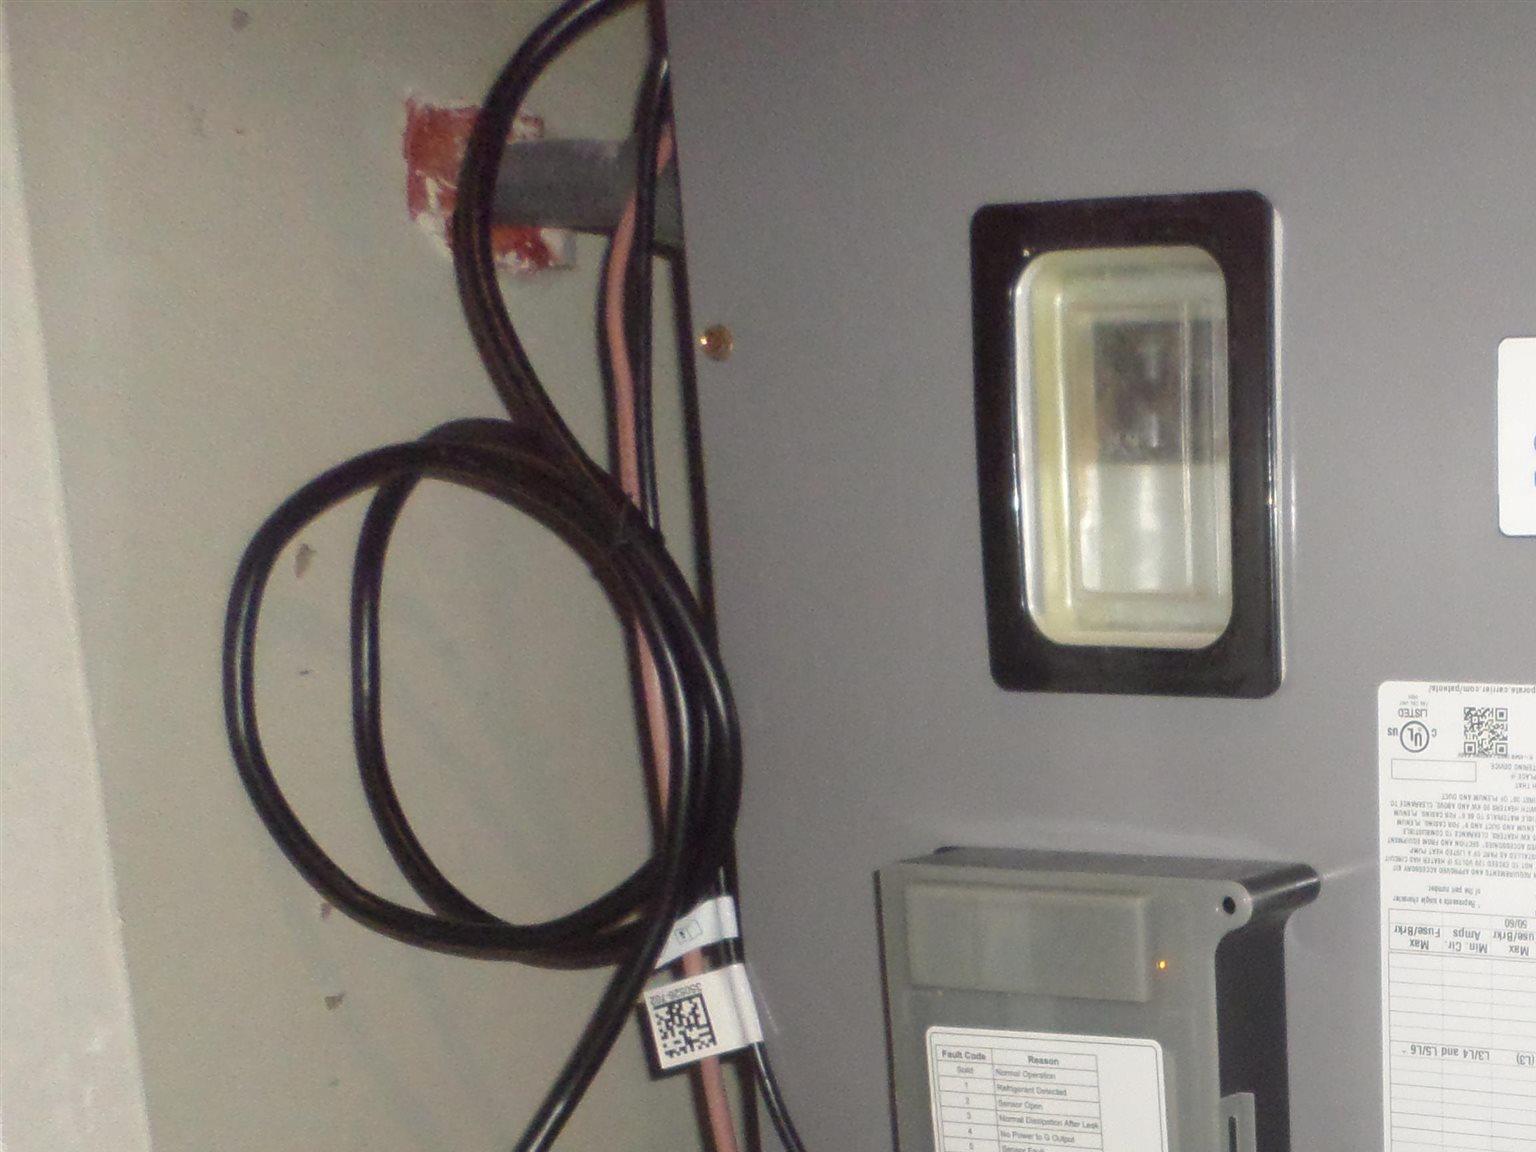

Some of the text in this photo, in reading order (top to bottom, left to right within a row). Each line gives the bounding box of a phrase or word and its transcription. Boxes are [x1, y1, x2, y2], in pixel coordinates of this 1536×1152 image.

[1398, 708, 1427, 718] LISTED
[1393, 895, 1419, 904] character
[1443, 898, 1475, 908] Represents
[1394, 925, 1440, 938] Fuse/Brkr
[1452, 928, 1480, 941] Amps
[1409, 939, 1429, 950] Max
[1444, 940, 1487, 954] Min. Cir.
[1509, 945, 1529, 956] Max
[942, 1050, 963, 1058] Fault
[1410, 1044, 1490, 1061] L3/L4 and L5/L6
[1028, 1055, 1059, 1065] Reason
[1516, 1053, 1535, 1066] (L3)
[996, 1069, 1055, 1080] Normal Operation
[997, 1083, 1066, 1096] Refrigerant Detected
[998, 1100, 1043, 1111] Sensor Open
[999, 1114, 1099, 1129] Normal Dissipation After Leak
[1001, 1131, 1011, 1139] No
[1012, 1132, 1033, 1141] Power
[1036, 1133, 1042, 1141] to
[1052, 1135, 1075, 1144] Output
